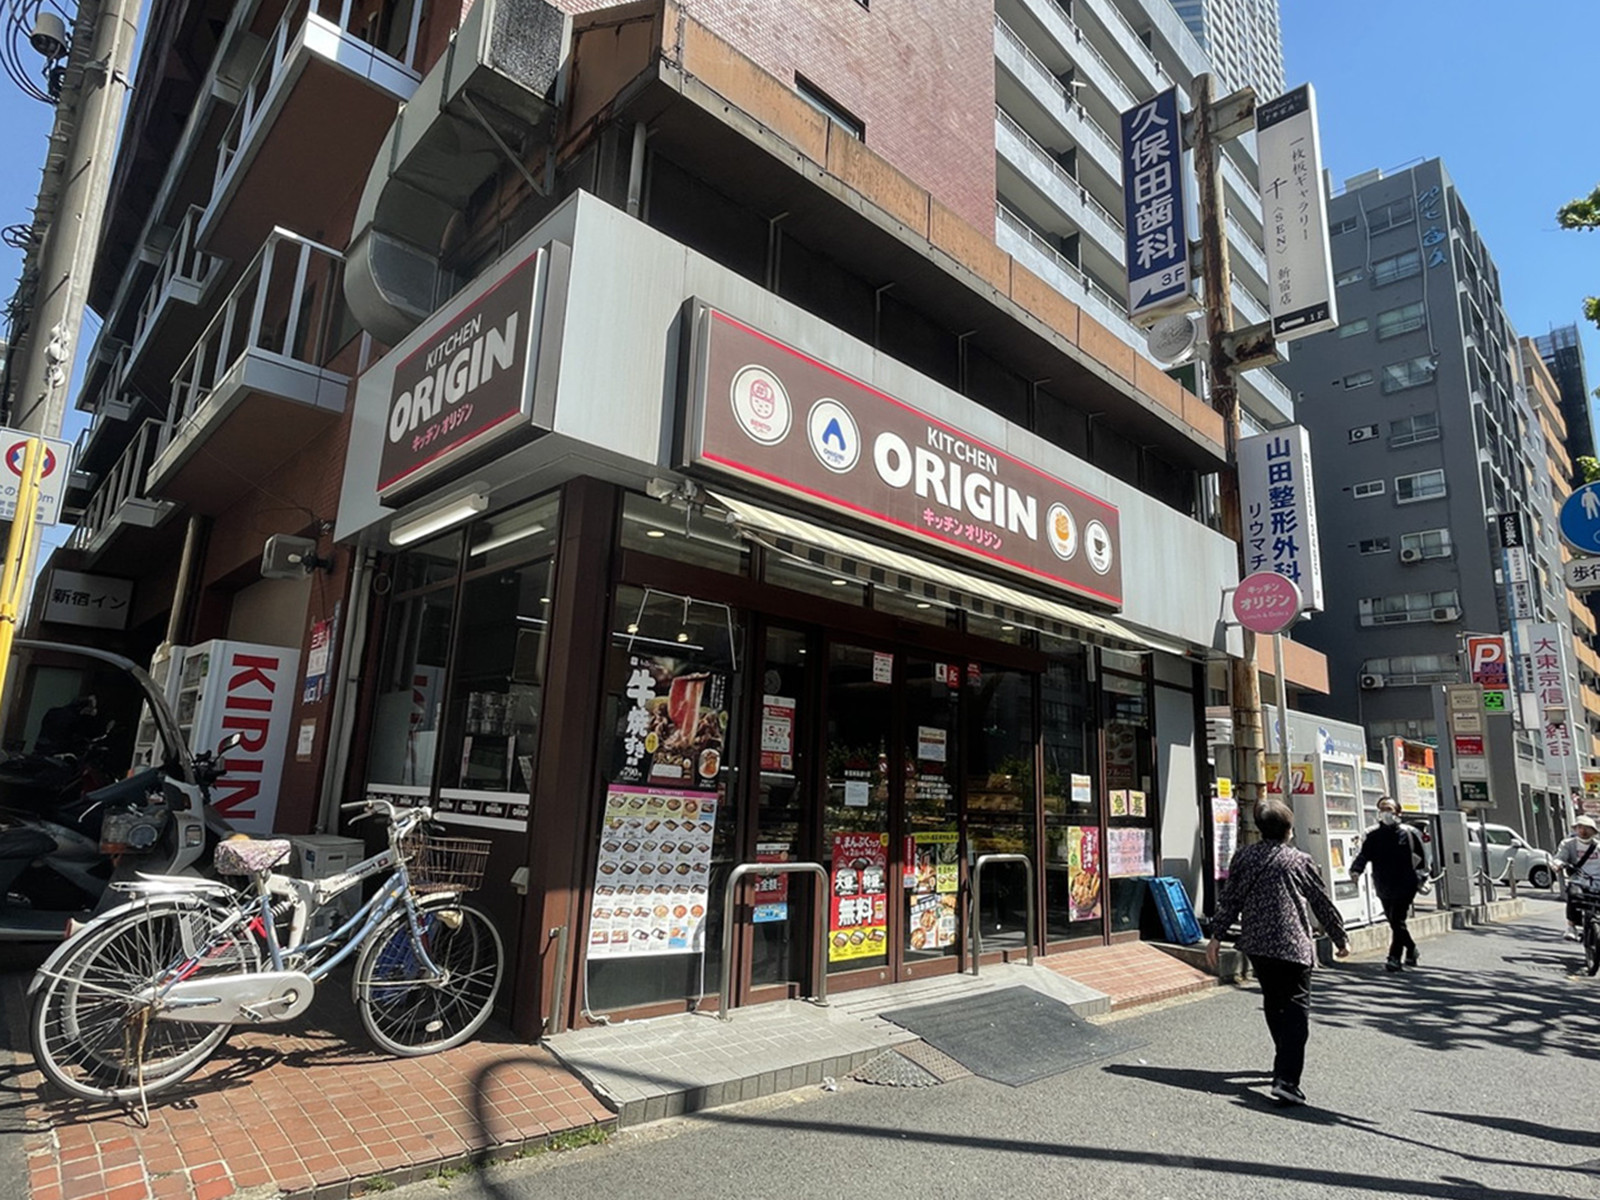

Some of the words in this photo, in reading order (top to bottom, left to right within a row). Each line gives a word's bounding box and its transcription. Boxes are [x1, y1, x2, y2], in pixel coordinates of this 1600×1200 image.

[1130, 101, 1177, 269] 久保田歯科
[1290, 137, 1309, 240] 一枚板ギャラリー
[1161, 267, 1185, 286] 3F
[1309, 310, 1325, 321] 1F
[426, 313, 482, 372] KITCHEN
[389, 311, 518, 443] ORIGIN
[927, 427, 998, 475] KITCHEN
[873, 431, 1037, 541] ORIGIN
[1249, 502, 1267, 571] リウマチ
[52, 588, 126, 609] 新宿イン
[1240, 594, 1291, 611] オリジン
[1247, 583, 1280, 594] キッチン
[1474, 644, 1501, 673] P
[1533, 638, 1570, 757] 大東京信組合
[208, 653, 280, 820] KIRIN
[1272, 769, 1310, 792] 10円
[838, 896, 873, 927] 無料
